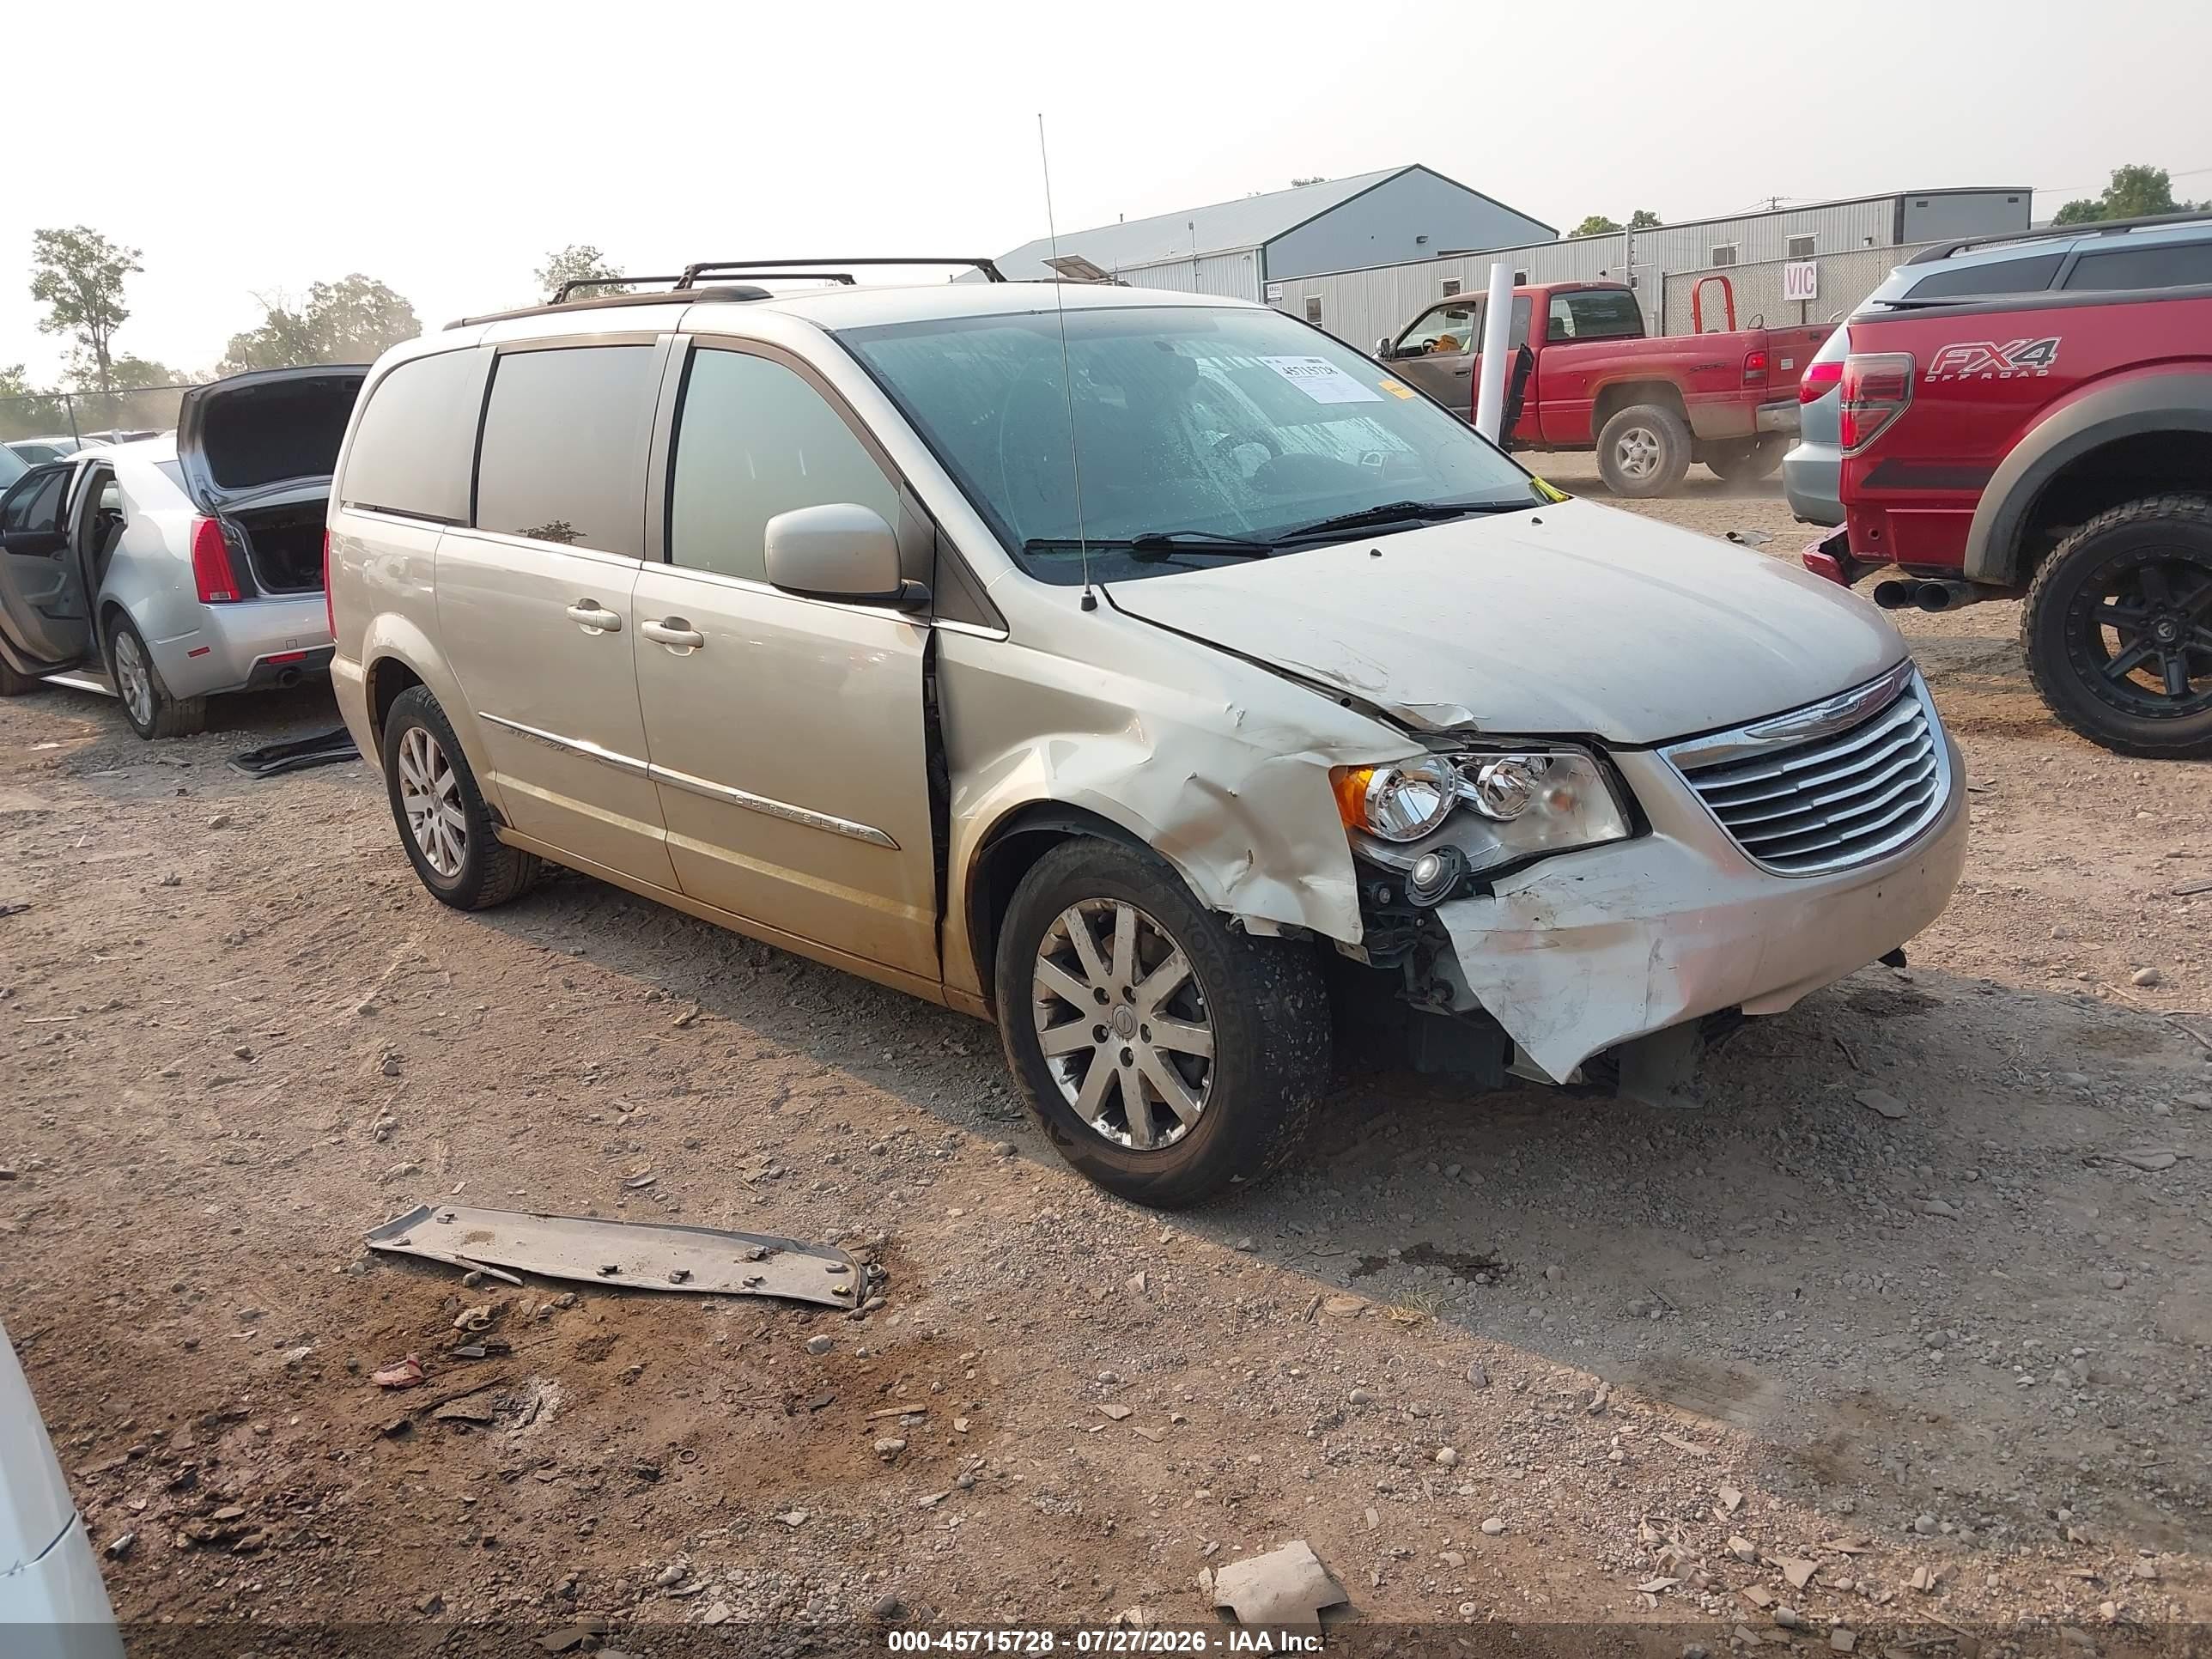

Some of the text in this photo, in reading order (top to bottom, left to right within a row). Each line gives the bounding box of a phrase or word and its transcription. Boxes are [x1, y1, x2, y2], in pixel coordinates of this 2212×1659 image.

[1787, 266, 1814, 295] VIC
[1927, 337, 2062, 375] FX4
[1282, 366, 1339, 376] 45715728
[1923, 369, 2050, 383] OFF ROAD
[734, 794, 870, 839] CHRYSLER
